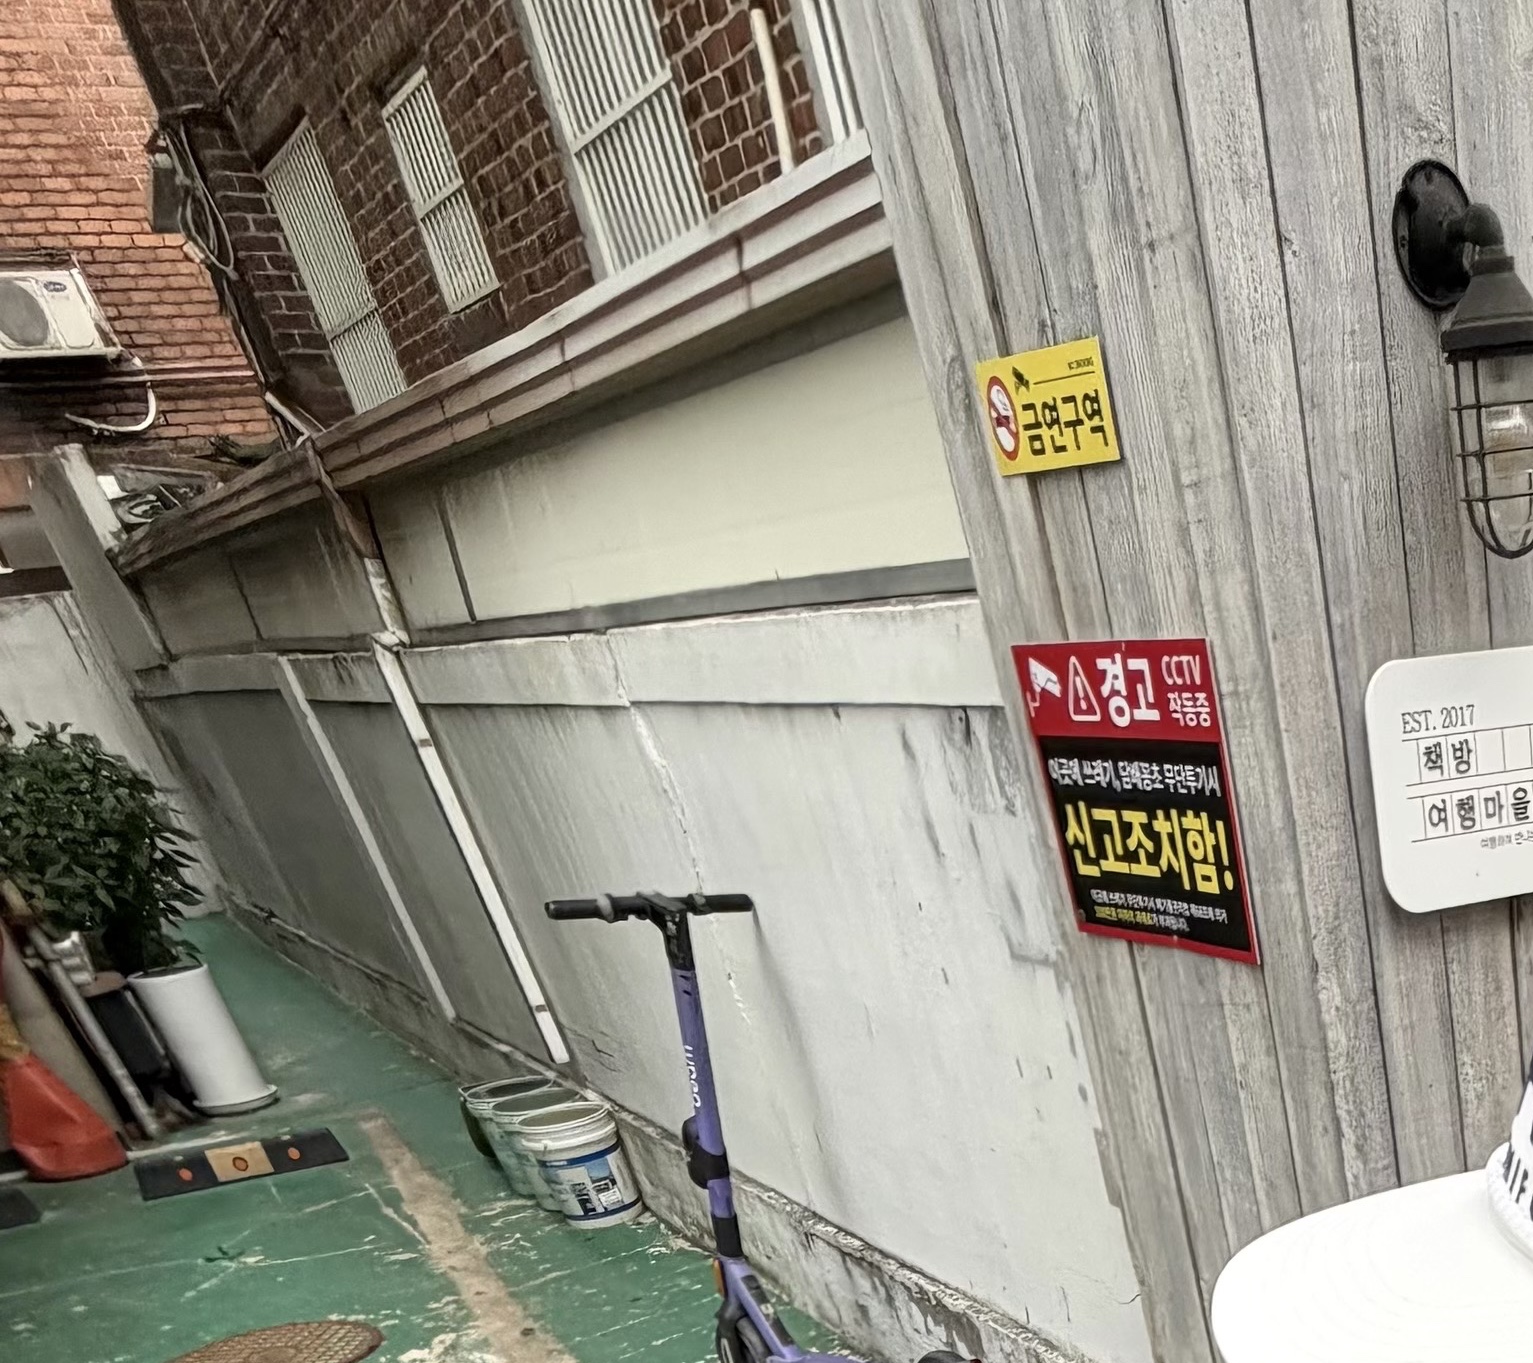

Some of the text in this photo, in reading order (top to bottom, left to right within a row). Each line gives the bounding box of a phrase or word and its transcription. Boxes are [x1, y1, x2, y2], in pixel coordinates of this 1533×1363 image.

[1021, 388, 1109, 456] 금연구역
[1095, 652, 1161, 728] 경고
[1161, 654, 1202, 686] CCTV
[1167, 691, 1212, 728] 작동중
[1400, 704, 1475, 735] EST. 2017
[1422, 738, 1473, 777] 책방
[1428, 786, 1532, 833] 여행마을
[1064, 800, 1234, 895] 신고조치함!
